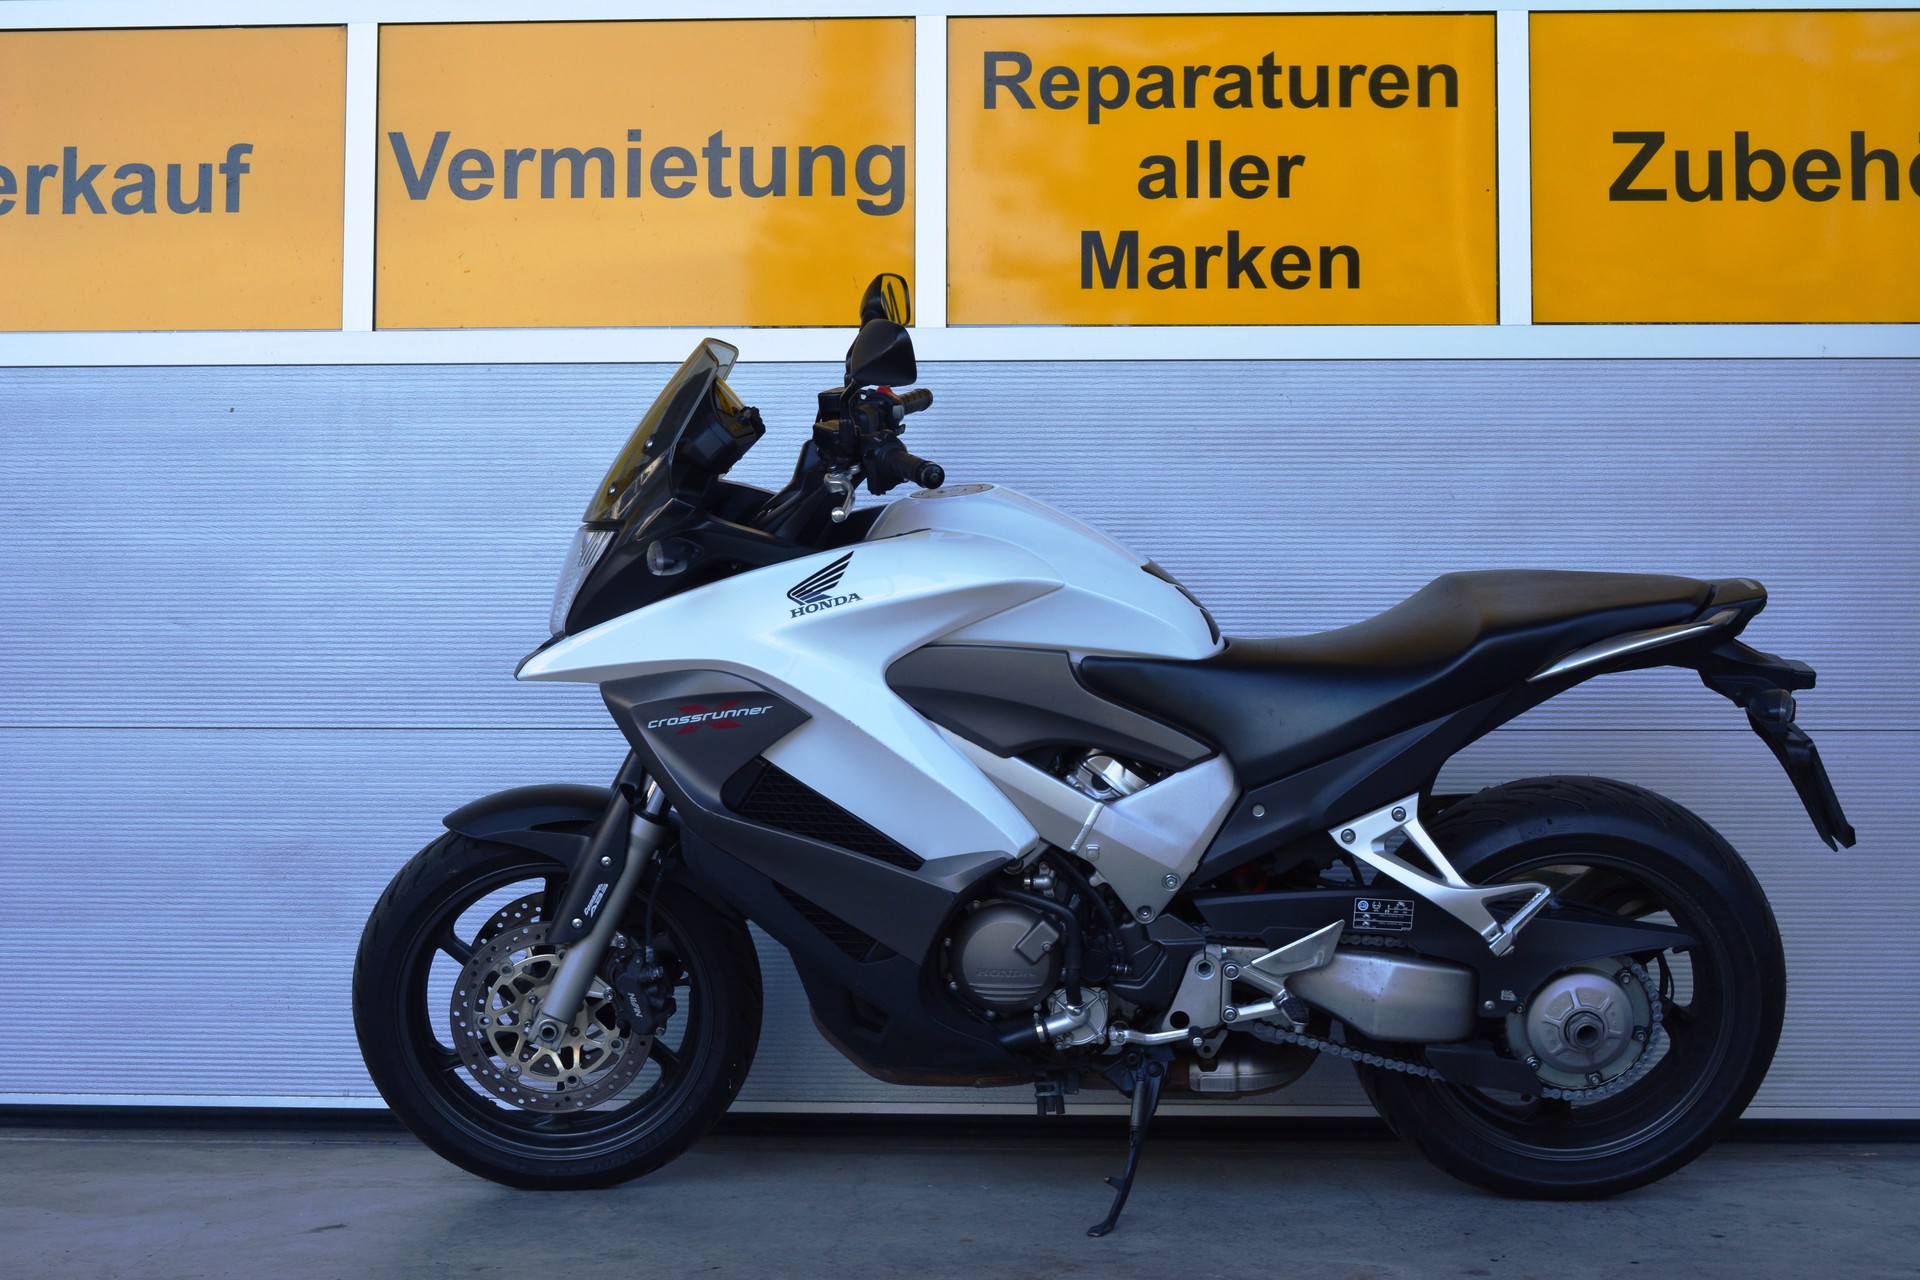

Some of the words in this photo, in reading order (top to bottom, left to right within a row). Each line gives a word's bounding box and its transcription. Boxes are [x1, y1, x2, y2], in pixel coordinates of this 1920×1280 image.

[984, 51, 1459, 125] Reparaturen
[388, 129, 906, 217] Vermietung
[1138, 140, 1307, 200] aller
[1609, 130, 1920, 203] Zubeh
[1081, 230, 1361, 291] Marken
[789, 592, 863, 619] HONDA
[647, 705, 774, 729] crossrunner
